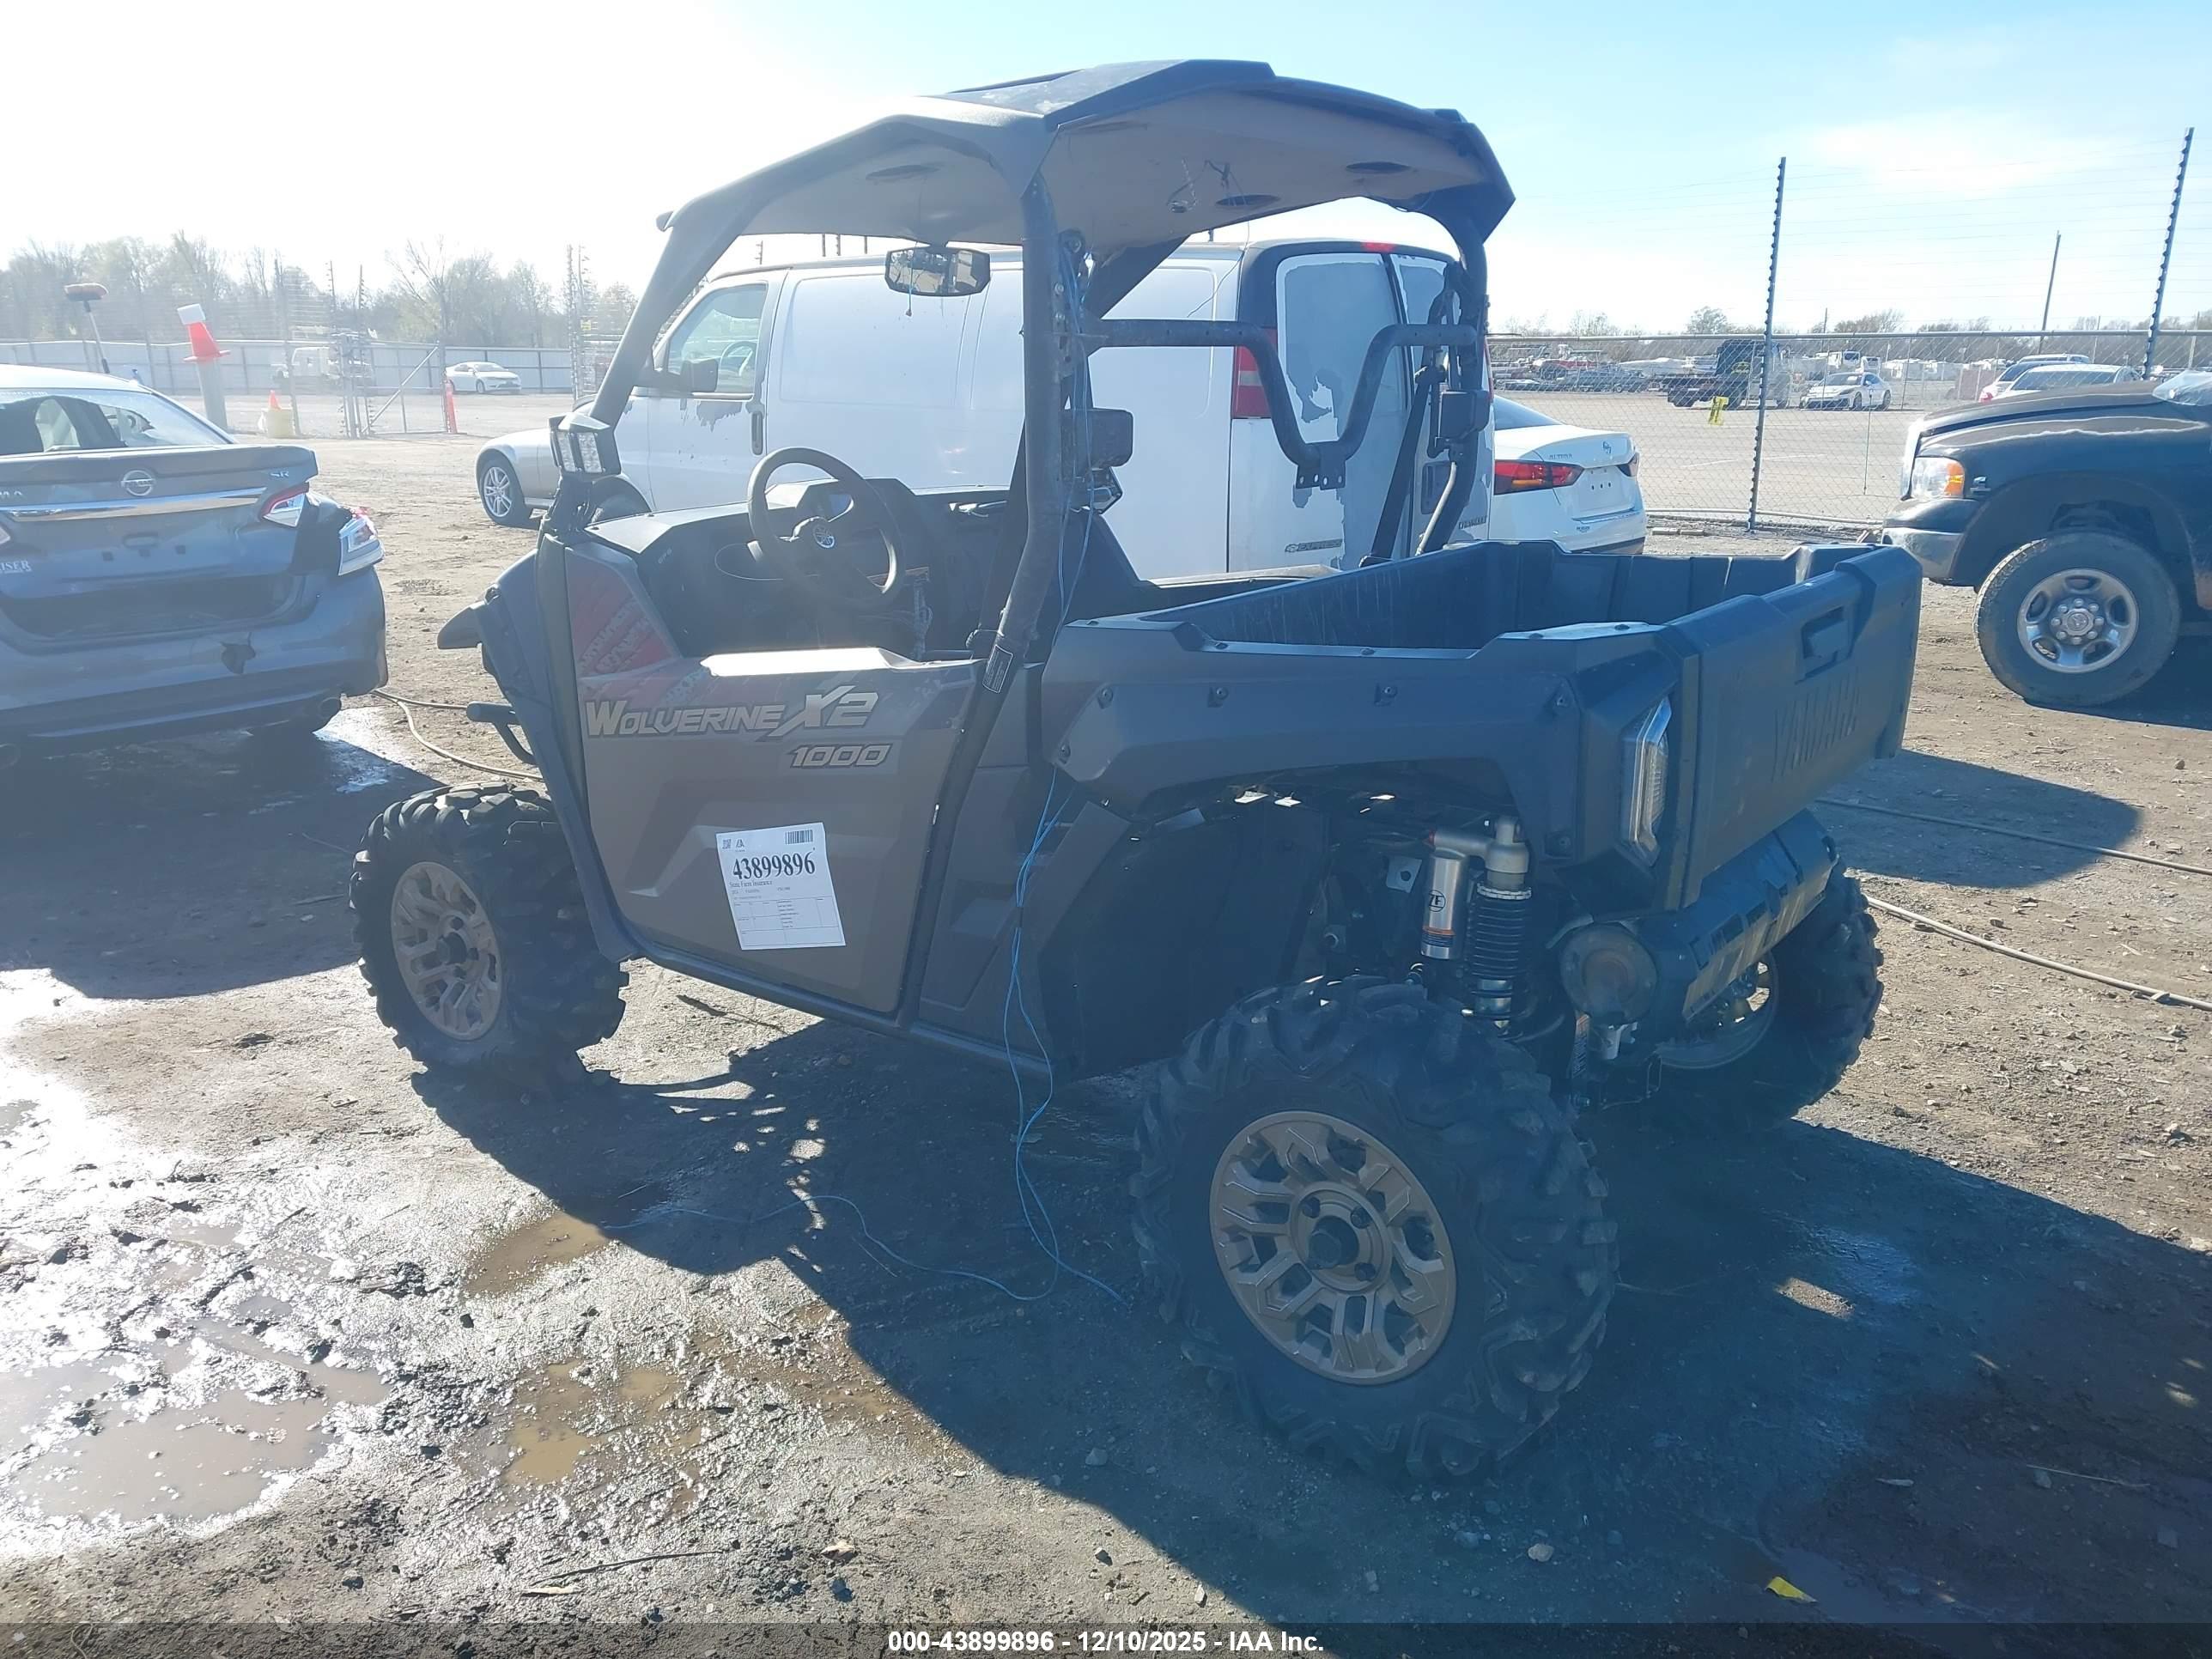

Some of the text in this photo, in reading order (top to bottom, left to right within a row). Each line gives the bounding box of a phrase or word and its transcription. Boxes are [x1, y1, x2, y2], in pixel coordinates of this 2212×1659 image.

[765, 684, 880, 740] X2
[788, 744, 893, 769] 1000
[732, 851, 816, 879] 43899896
